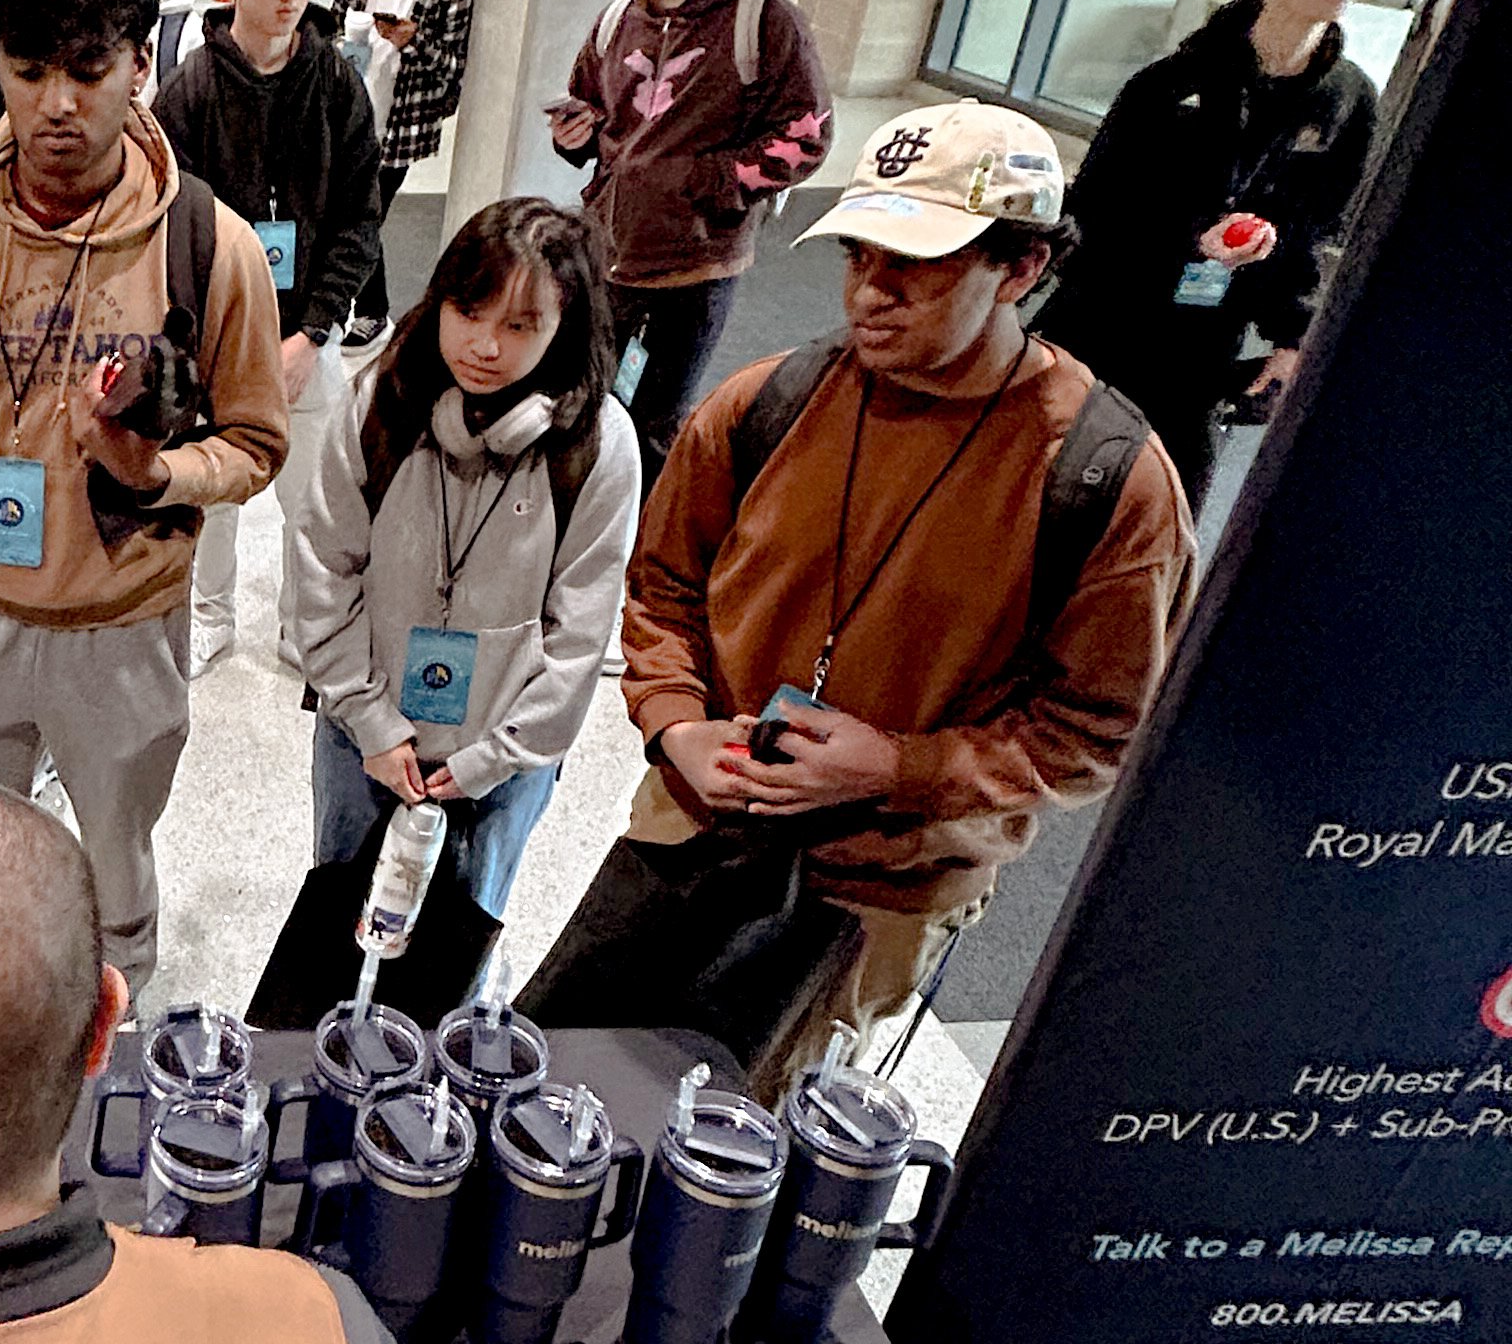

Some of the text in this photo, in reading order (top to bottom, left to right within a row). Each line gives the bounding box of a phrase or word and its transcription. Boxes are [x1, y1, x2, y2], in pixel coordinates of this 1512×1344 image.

[1440, 762, 1512, 799] US
[1305, 819, 1445, 869] Royal
[1292, 1063, 1465, 1102] Highest
[1102, 1113, 1204, 1143] DPV
[1205, 1111, 1320, 1146] (U.S.)
[1332, 1118, 1359, 1137] +
[1091, 1234, 1173, 1261] Talk
[1184, 1236, 1228, 1258] to
[1239, 1238, 1267, 1257] a
[1277, 1230, 1435, 1257] Melissa
[1210, 1299, 1464, 1327] 800.MELISSA
